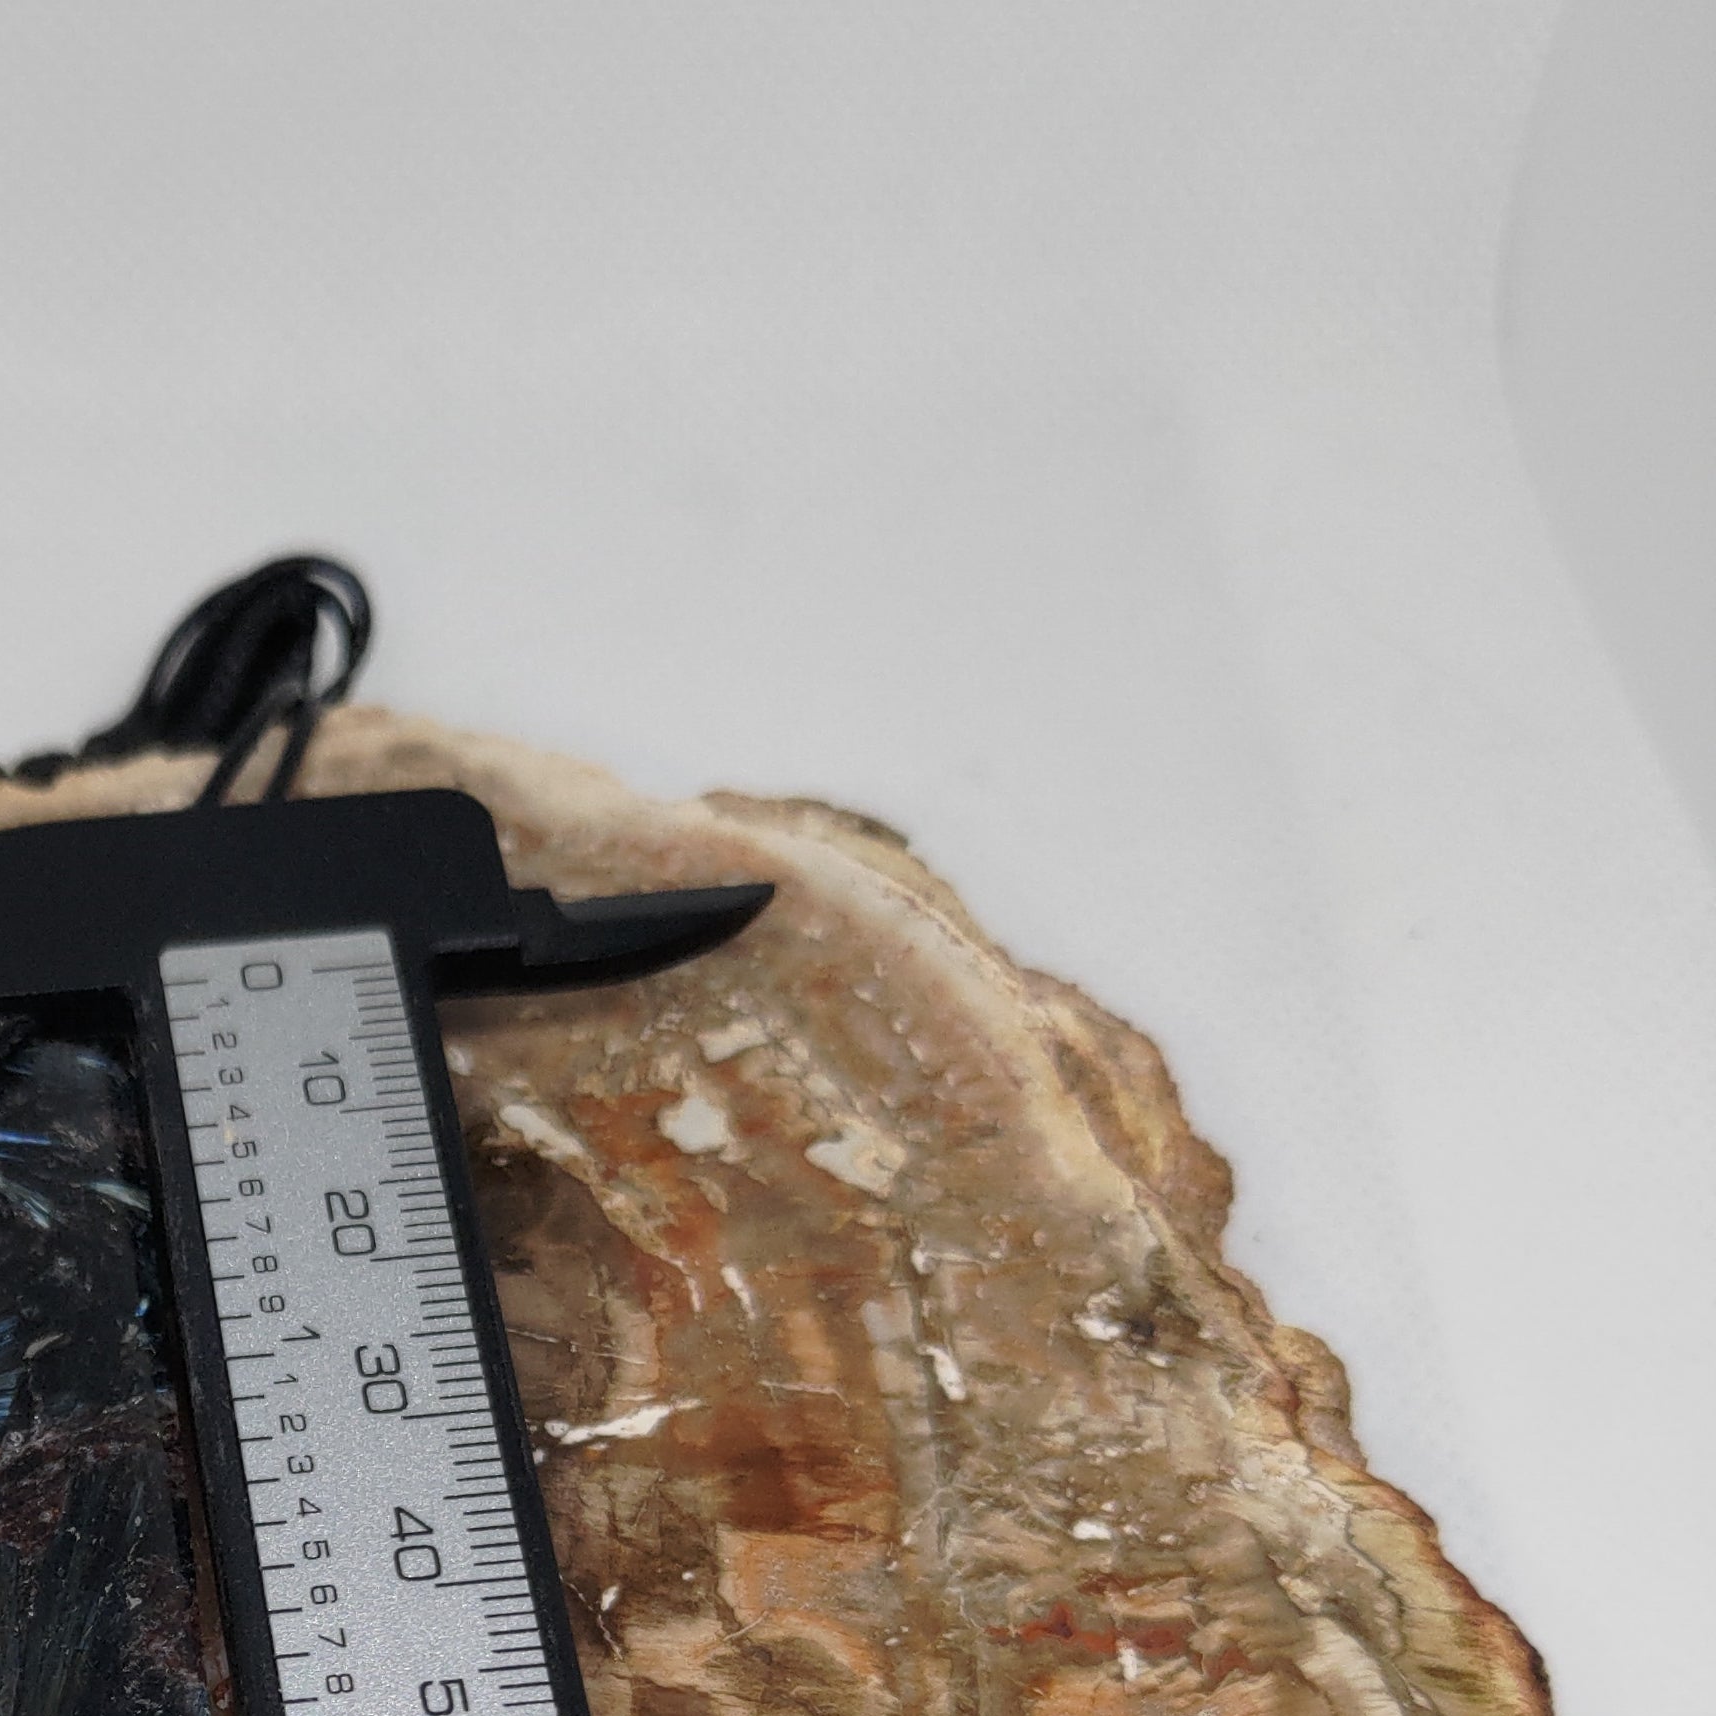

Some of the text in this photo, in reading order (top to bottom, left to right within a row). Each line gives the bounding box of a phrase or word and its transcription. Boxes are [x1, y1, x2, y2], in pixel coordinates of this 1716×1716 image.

[206, 996, 231, 1010] 1
[211, 1032, 238, 1051] 2
[218, 1066, 245, 1086] 3
[228, 1103, 252, 1122] 4
[230, 1139, 259, 1160] 5
[237, 1178, 266, 1198] 6
[245, 1215, 273, 1235] 7
[239, 961, 284, 992] 0
[299, 1051, 347, 1107] 10
[323, 1188, 378, 1258] 20
[353, 1342, 410, 1415] 30
[389, 1505, 443, 1583] 40
[251, 1254, 280, 1274] 8
[258, 1294, 287, 1314] 9
[280, 1324, 322, 1343] 1
[273, 1372, 300, 1386] 1
[278, 1413, 308, 1434] 2
[286, 1454, 316, 1475] 3
[296, 1496, 323, 1518] 4
[301, 1539, 332, 1561] 5
[309, 1583, 340, 1606] 6
[317, 1627, 348, 1649] 7
[324, 1672, 356, 1696] 8
